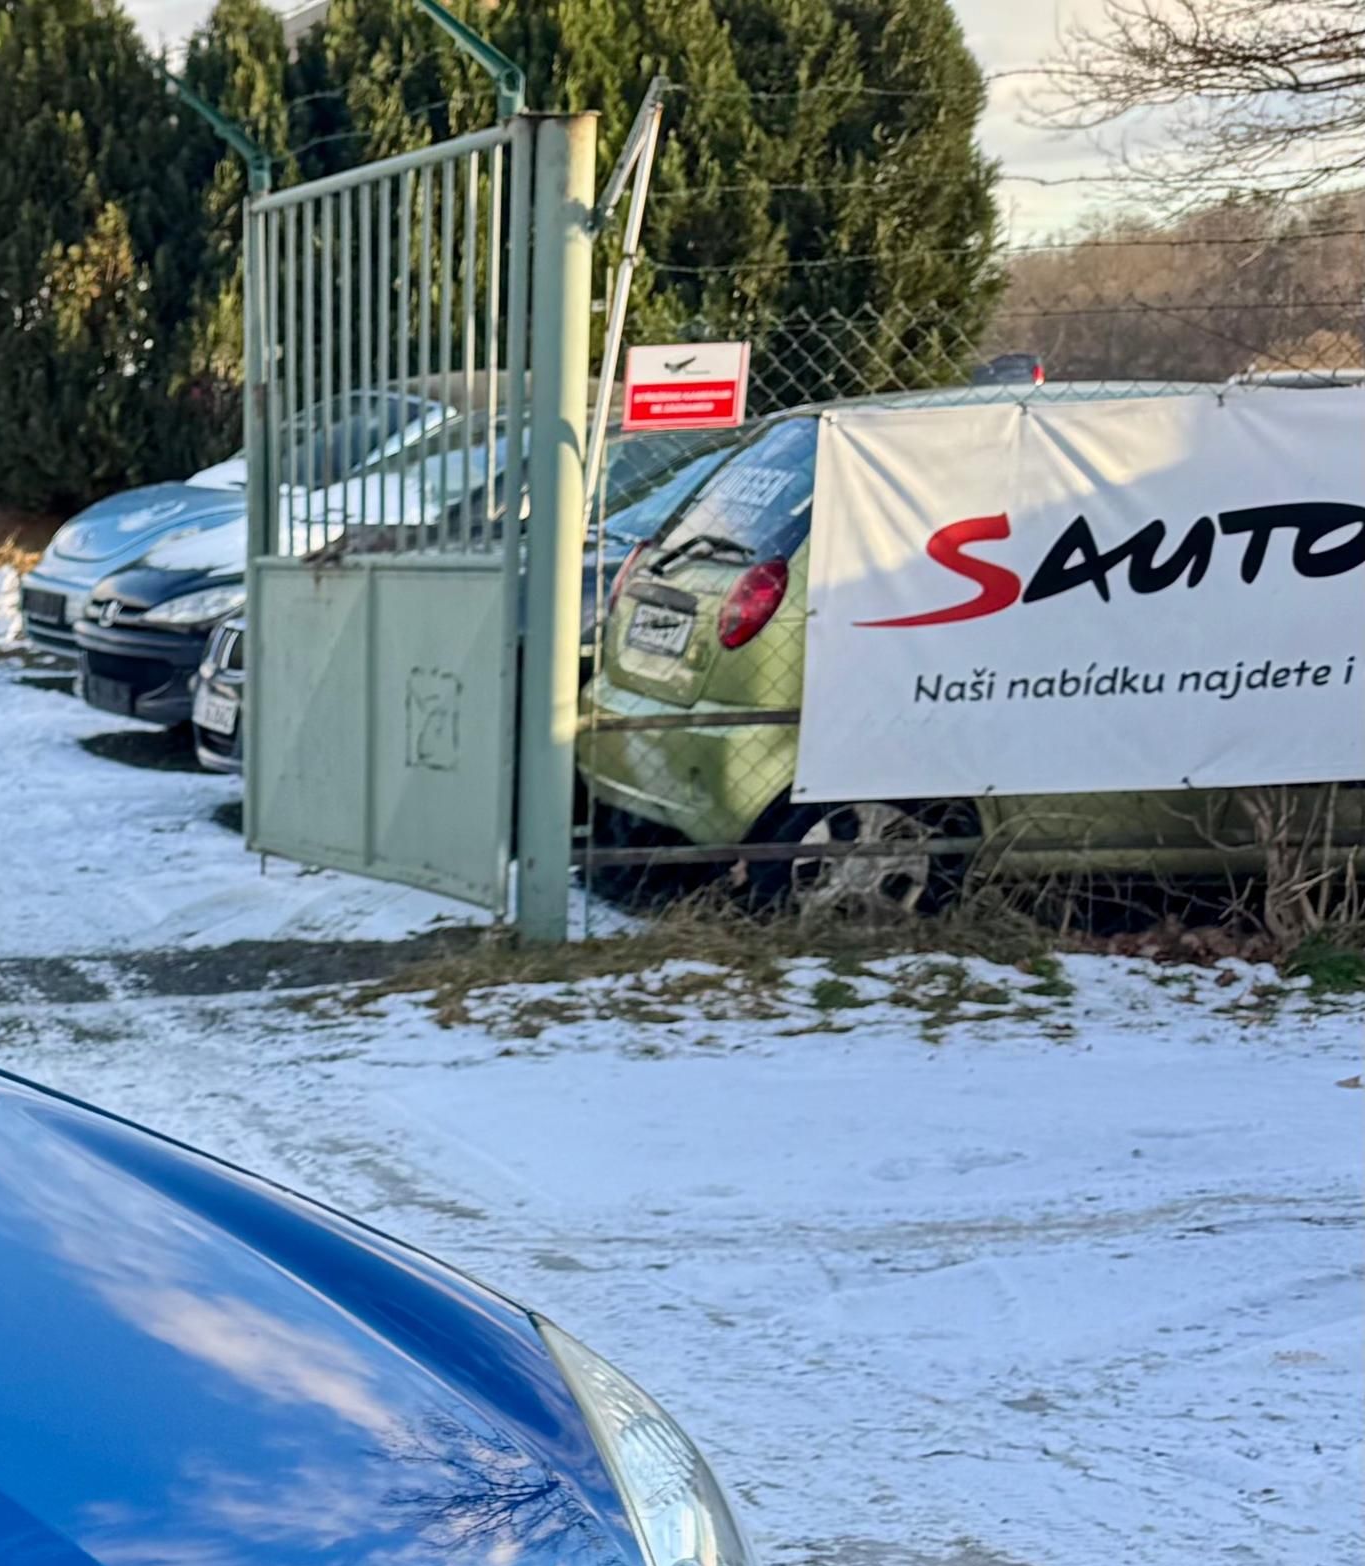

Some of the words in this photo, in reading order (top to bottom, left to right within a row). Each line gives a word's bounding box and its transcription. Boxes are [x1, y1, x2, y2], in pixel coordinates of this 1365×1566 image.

[913, 667, 997, 704] Naši
[1006, 661, 1166, 700] nabídku
[1176, 659, 1333, 701] najdete
[1342, 655, 1357, 686] i
